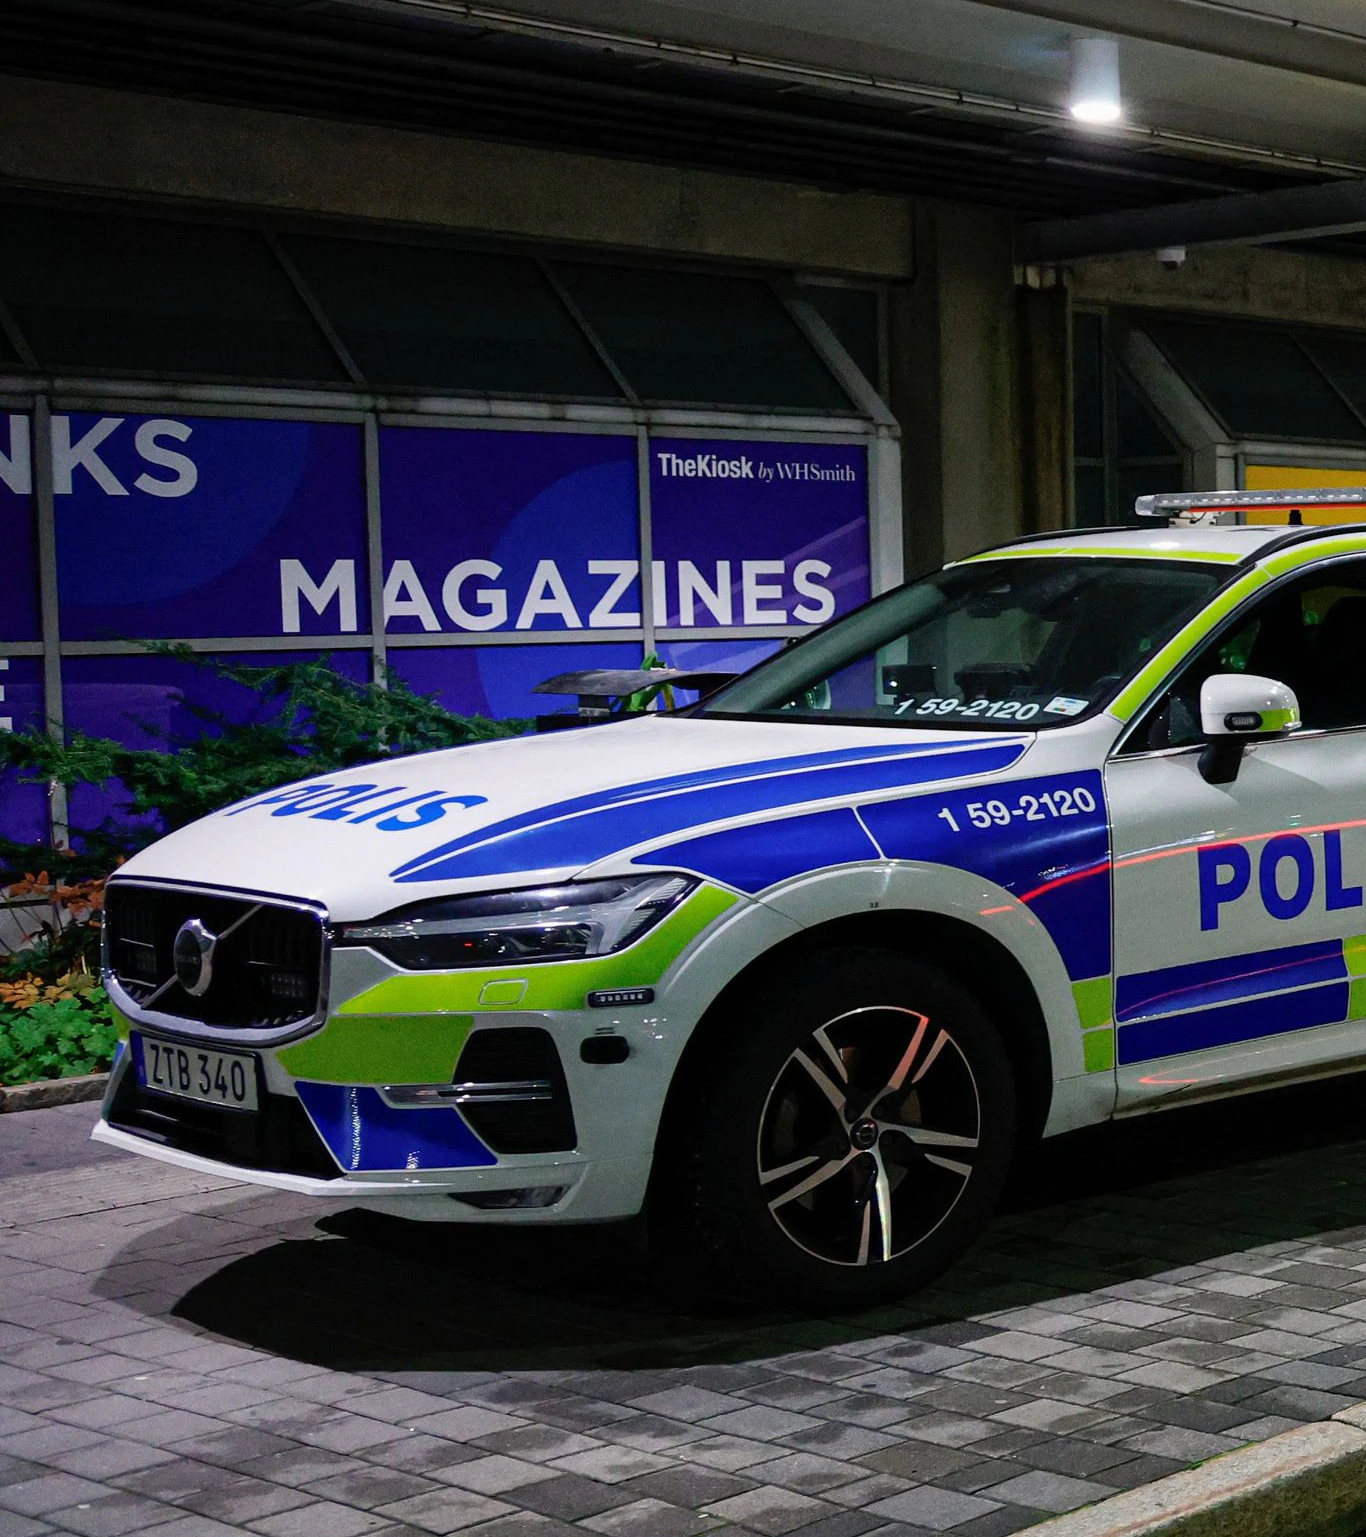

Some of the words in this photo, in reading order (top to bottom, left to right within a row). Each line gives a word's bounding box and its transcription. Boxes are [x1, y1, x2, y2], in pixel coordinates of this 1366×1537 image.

[658, 453, 754, 479] TheKiosk
[758, 462, 774, 482] by
[776, 463, 855, 482] WHSmith
[280, 559, 836, 632] MAGAZINES
[894, 699, 914, 715] 1
[916, 698, 1040, 721] 59-2120
[223, 784, 489, 832] POLIS
[937, 807, 960, 832] 1
[966, 787, 1096, 829] 59-2120
[150, 1043, 190, 1091] ZTB
[198, 1053, 245, 1102] 340
